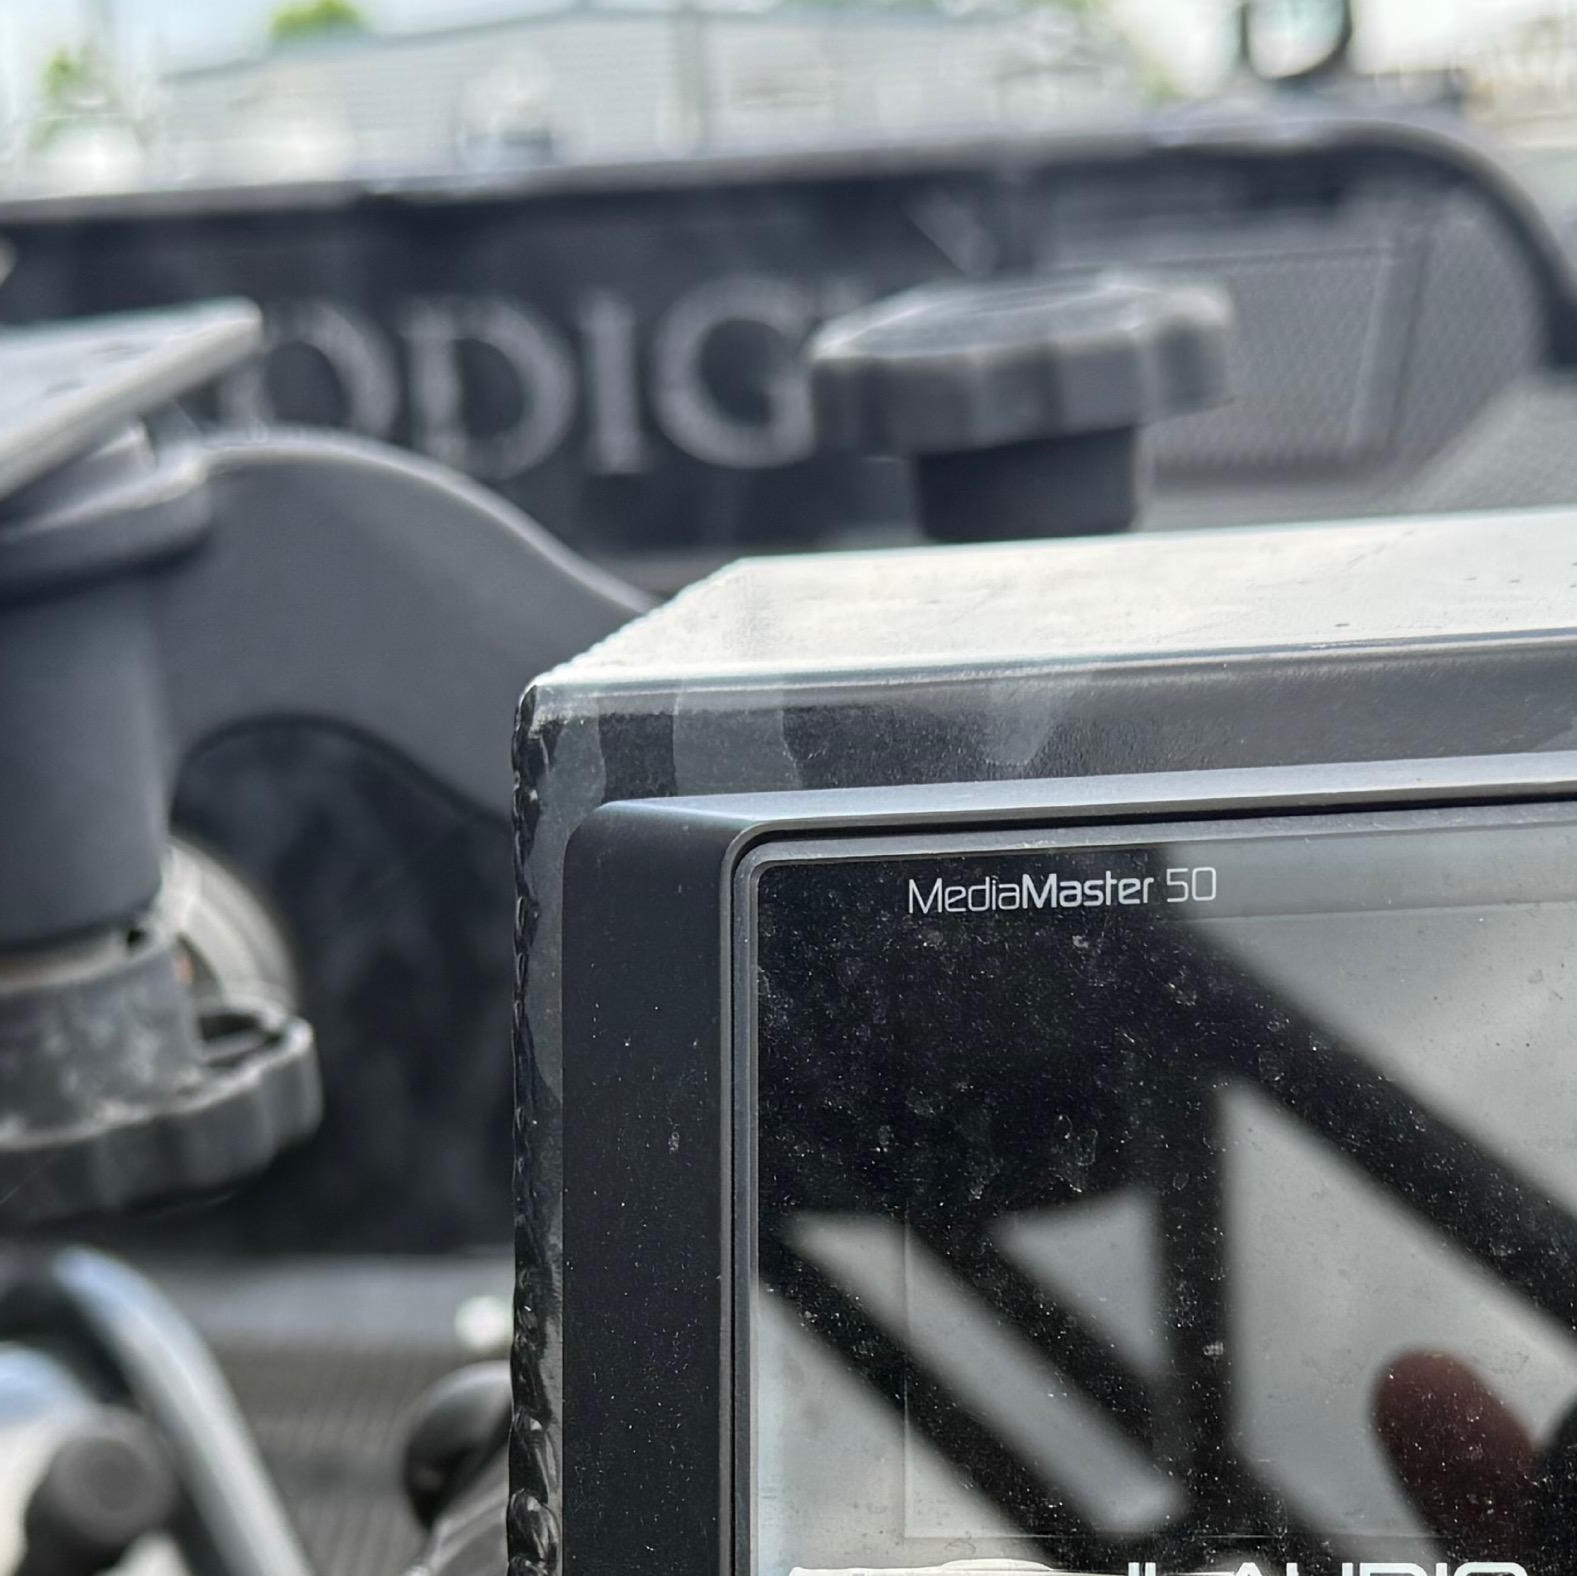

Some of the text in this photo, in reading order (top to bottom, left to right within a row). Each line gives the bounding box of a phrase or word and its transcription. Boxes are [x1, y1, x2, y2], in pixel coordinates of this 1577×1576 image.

[220, 276, 866, 478] ODIG
[908, 866, 1217, 914] MediaMaster 50
